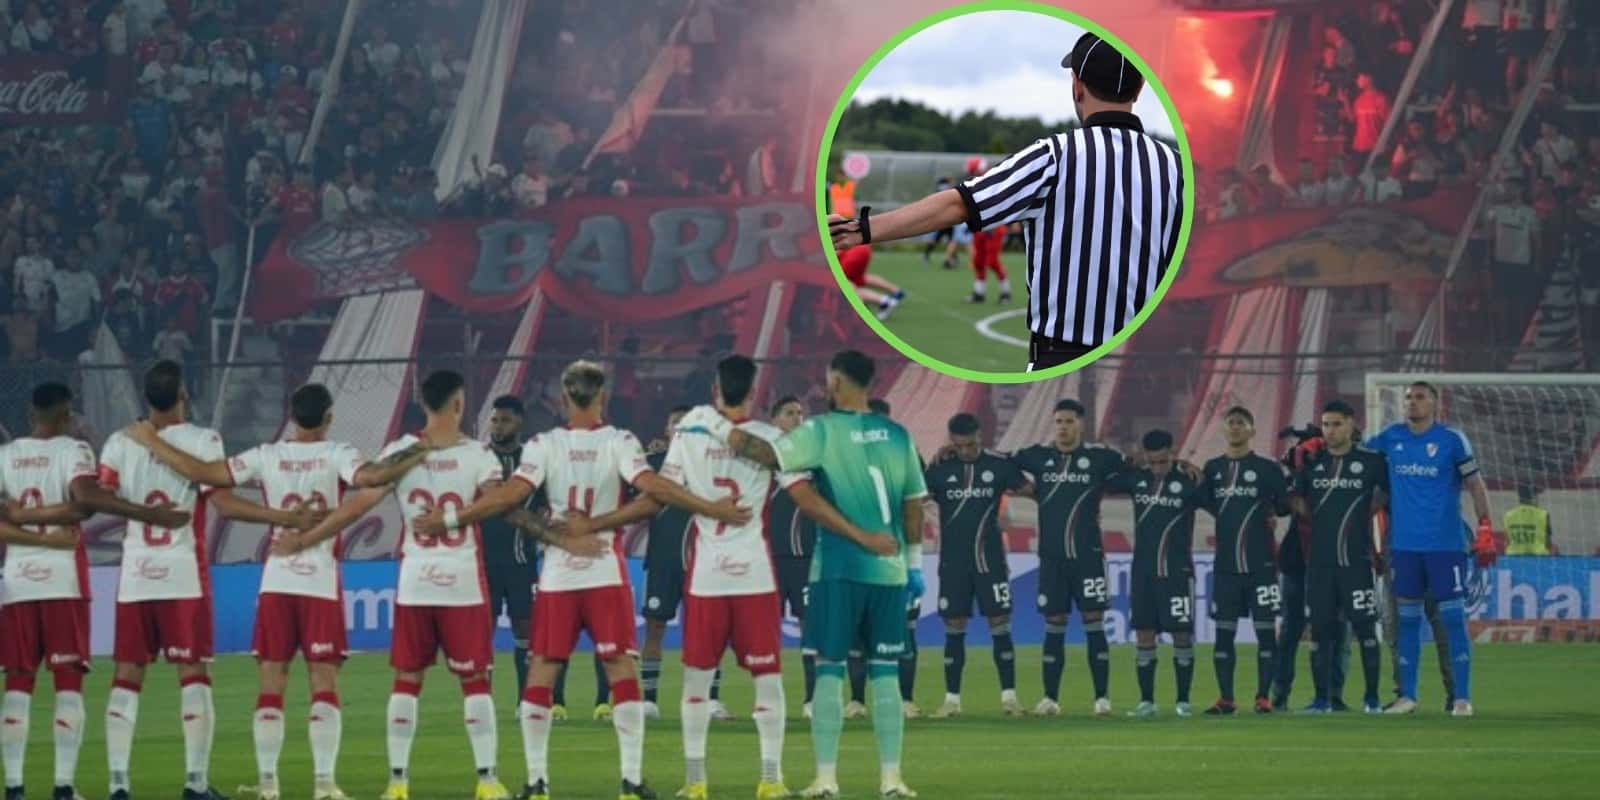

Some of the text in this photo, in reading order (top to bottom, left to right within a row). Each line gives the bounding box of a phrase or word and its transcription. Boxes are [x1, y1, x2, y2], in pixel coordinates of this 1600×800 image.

[469, 205, 824, 294] BARR
[1042, 469, 1090, 485] codere
[1312, 476, 1363, 489] codere
[868, 465, 891, 525] 1
[946, 485, 994, 500] codere
[1135, 492, 1182, 508] codere
[1083, 577, 1106, 598] 22
[1453, 565, 1463, 592] 1
[992, 583, 1010, 603] 13
[1256, 584, 1281, 606] 29
[1352, 589, 1376, 610] 23
[1170, 597, 1190, 616] 21
